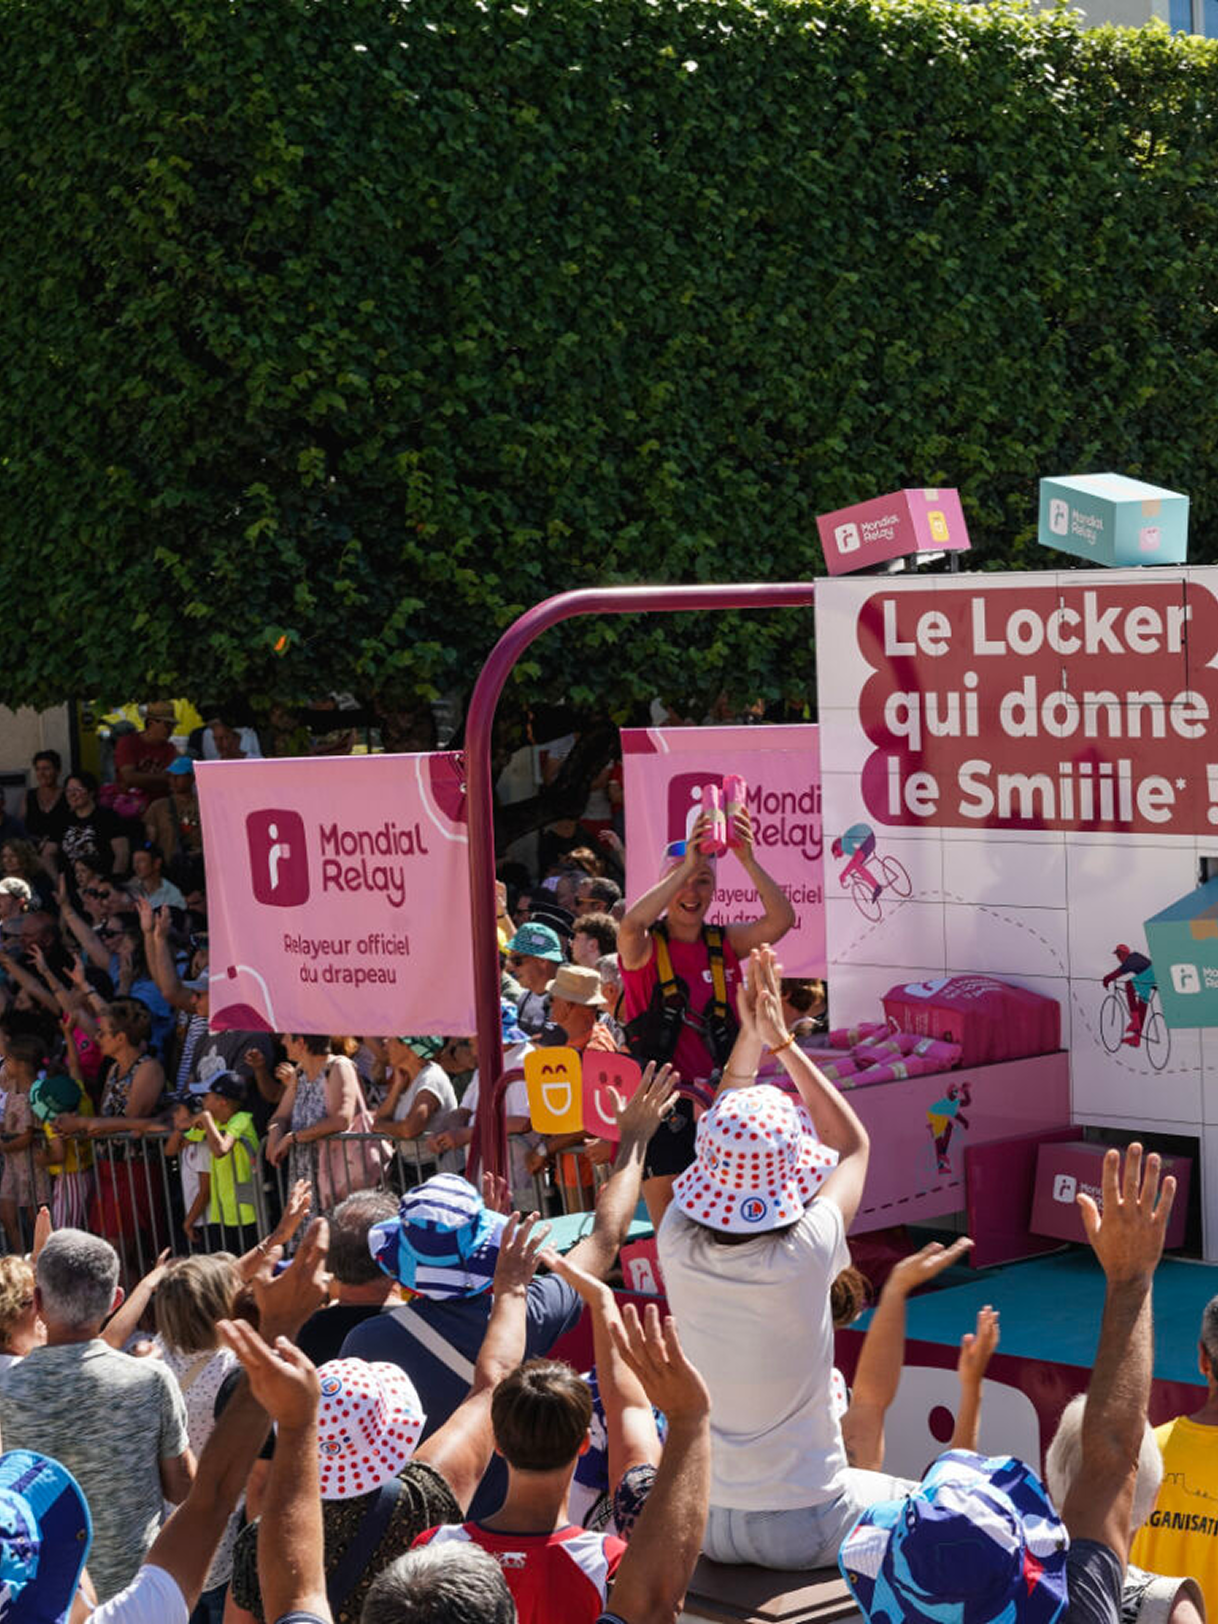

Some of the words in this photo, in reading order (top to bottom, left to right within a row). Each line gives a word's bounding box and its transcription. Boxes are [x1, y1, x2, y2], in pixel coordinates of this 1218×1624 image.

[860, 514, 900, 534] Mondial
[1072, 508, 1104, 531] Mondial
[863, 527, 895, 543] Relay
[1072, 522, 1096, 546] Relay
[883, 599, 952, 657] Le
[971, 590, 1193, 656] Locker
[884, 670, 980, 752] qui
[999, 675, 1210, 739] donne
[887, 755, 941, 818] le
[319, 822, 429, 856] Mondial
[322, 858, 406, 908] Relay
[284, 933, 352, 960] Relayeur
[357, 933, 410, 956] officiel
[299, 963, 318, 984] du
[322, 965, 397, 988] drapeau
